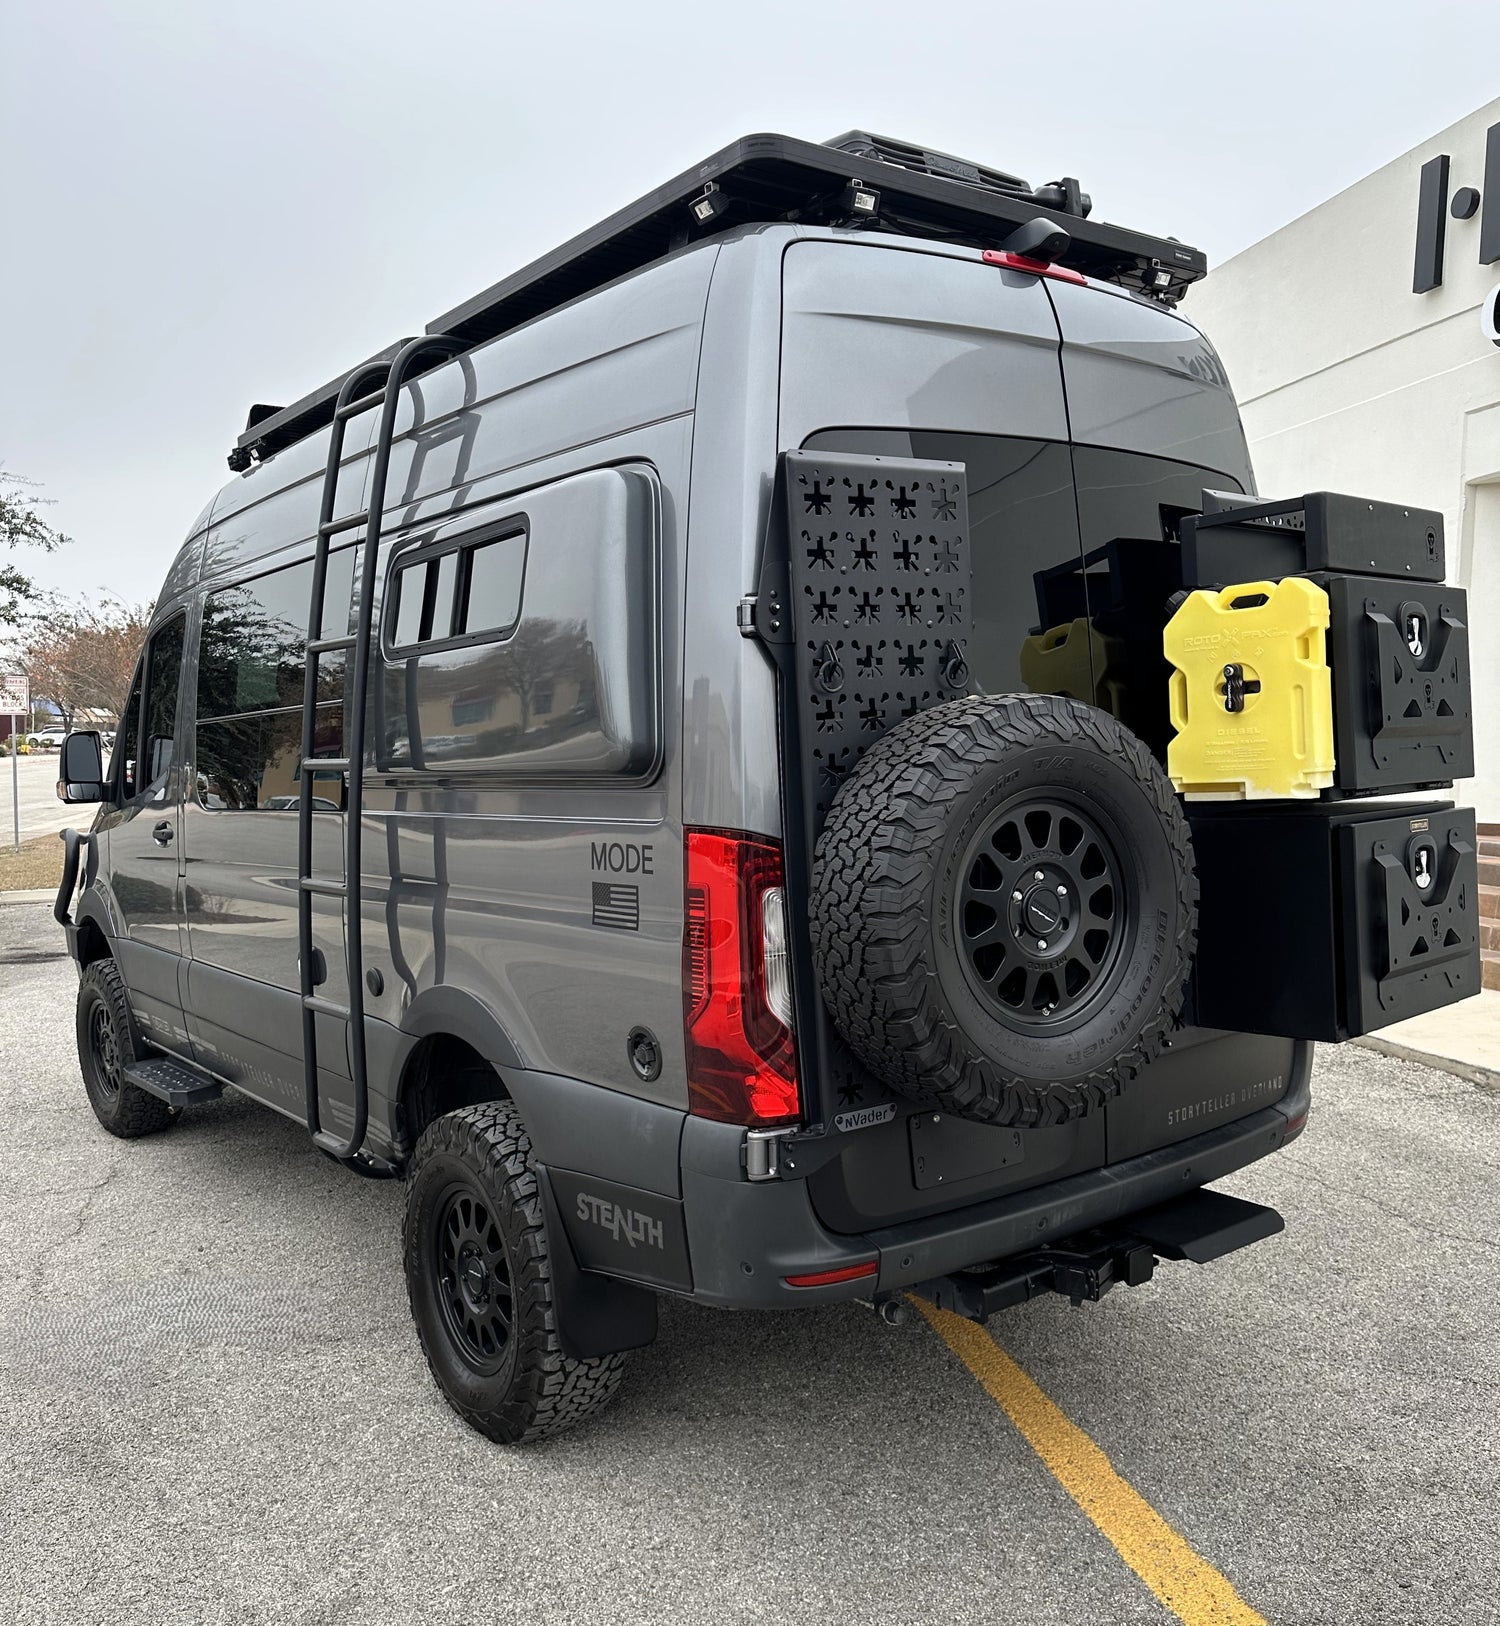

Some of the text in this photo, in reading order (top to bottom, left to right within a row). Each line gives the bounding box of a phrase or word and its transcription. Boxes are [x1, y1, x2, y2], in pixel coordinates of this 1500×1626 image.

[1183, 633, 1221, 647] ROTO
[1216, 727, 1262, 736] DIESEL
[591, 842, 654, 875] MODE
[1167, 1074, 1284, 1127] STORYTELLER OVERLAND
